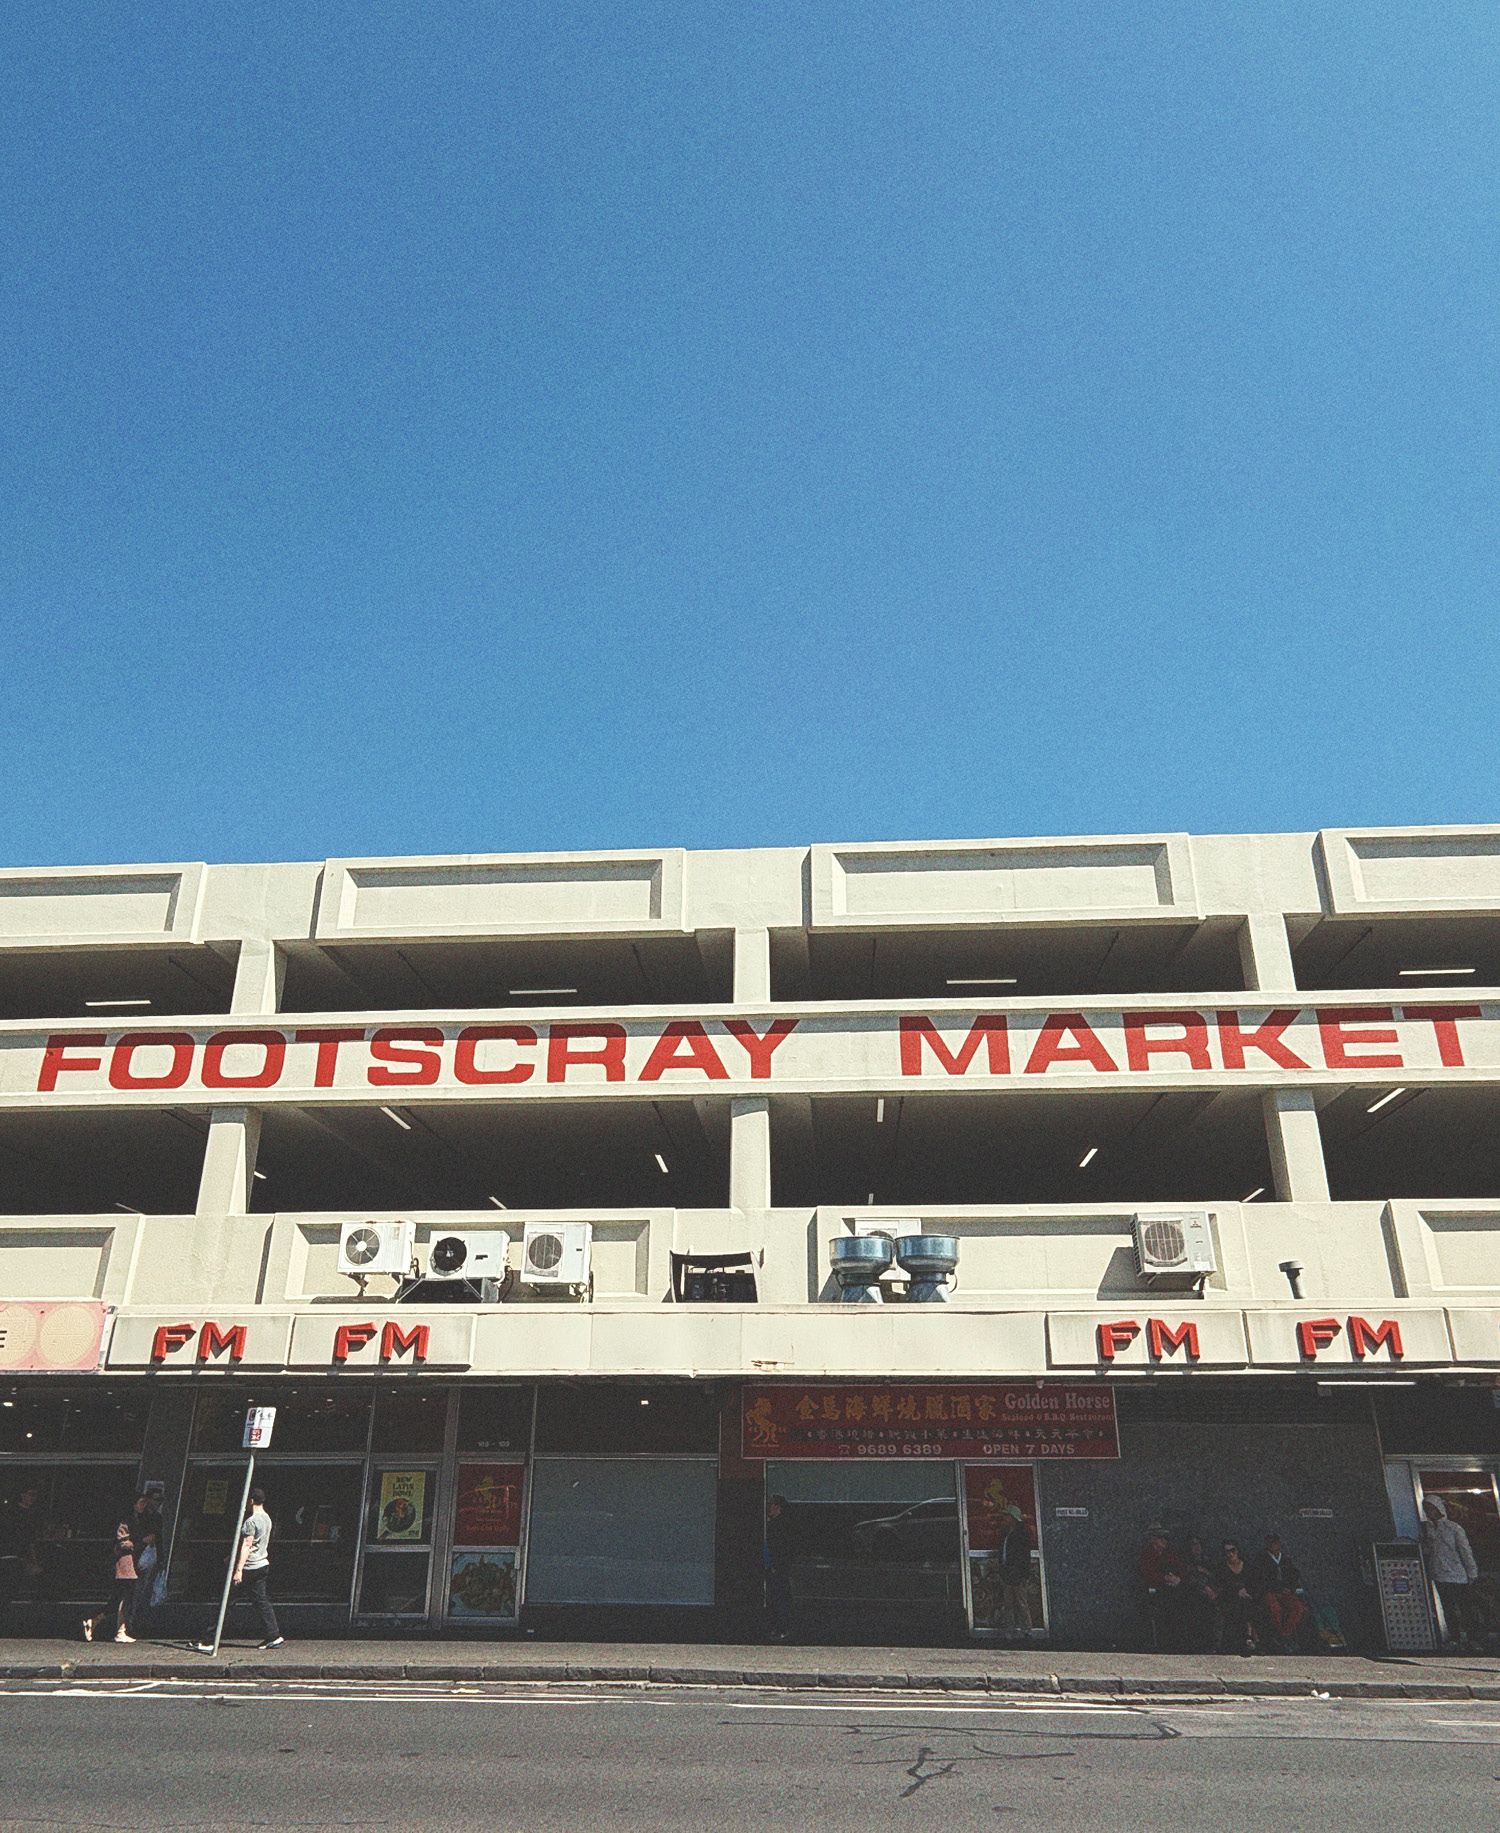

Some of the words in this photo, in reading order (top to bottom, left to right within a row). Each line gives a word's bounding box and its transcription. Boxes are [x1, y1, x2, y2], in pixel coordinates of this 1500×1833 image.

[37, 1019, 798, 1093] FOOTSCRAY
[899, 1006, 1482, 1076] MARKET
[152, 1322, 248, 1362] FM
[335, 1322, 430, 1362] FM
[1097, 1319, 1201, 1363] FM
[1297, 1317, 1404, 1362] FM
[1004, 1392, 1059, 1410] Golden
[1065, 1392, 1110, 1409] Horse
[857, 1444, 897, 1455] 9689
[902, 1444, 942, 1455] 6389
[982, 1444, 1019, 1455] OPEN
[1025, 1444, 1036, 1455] 7
[1040, 1444, 1075, 1455] DAYS
